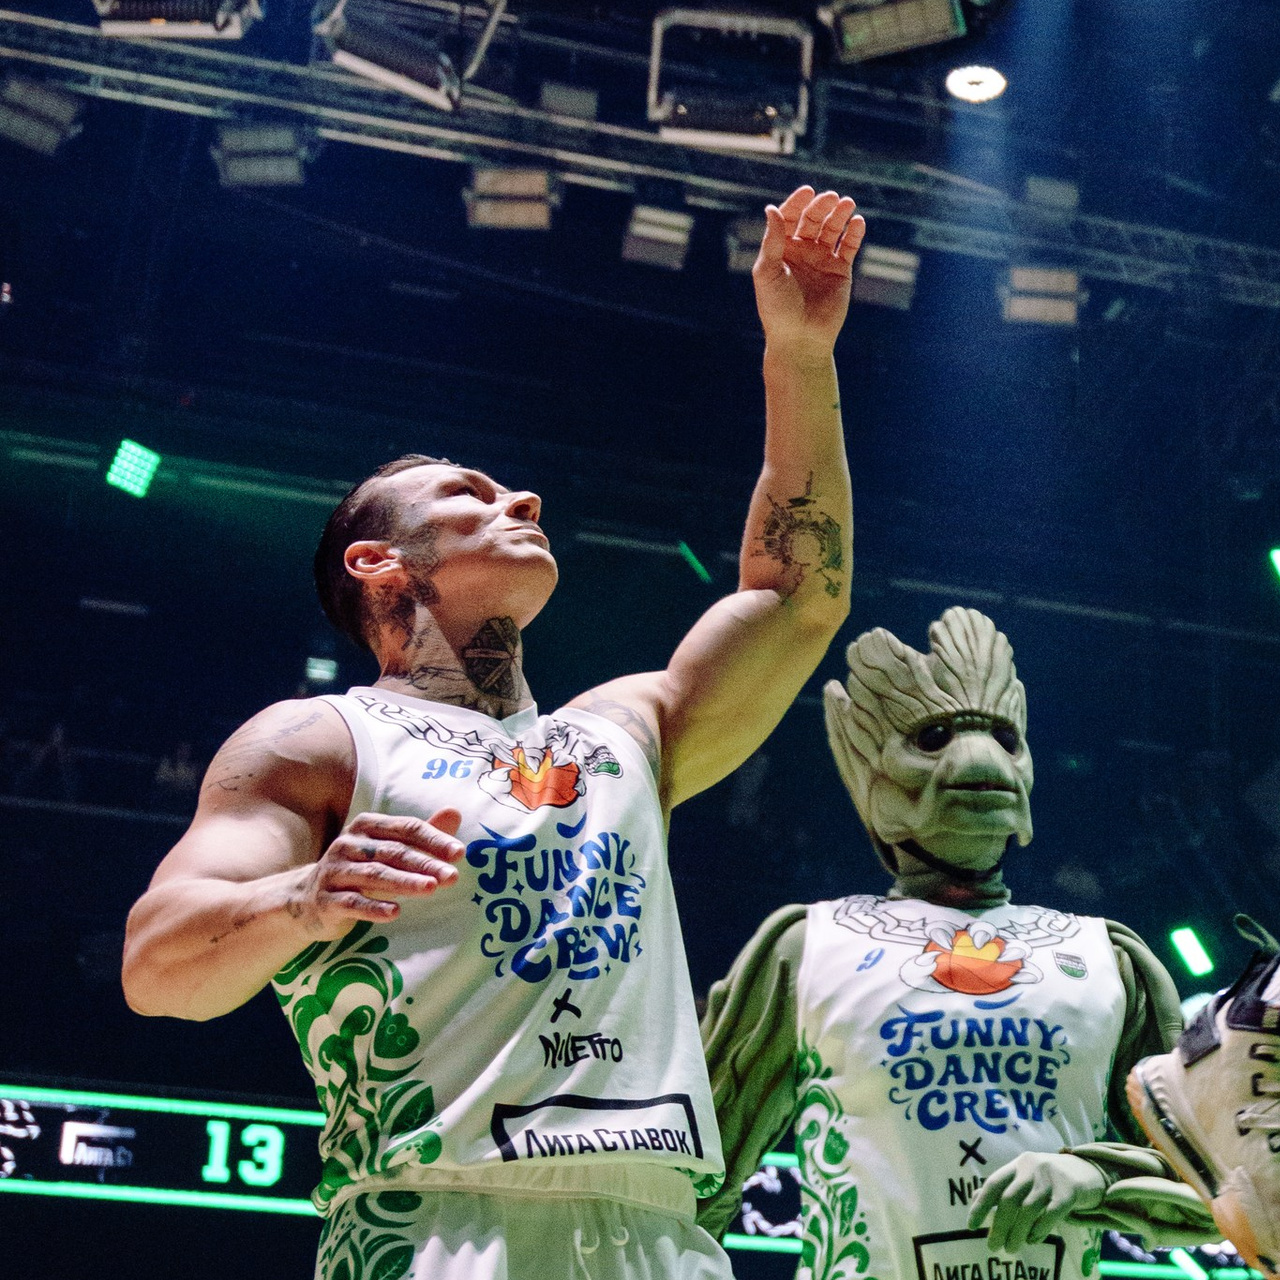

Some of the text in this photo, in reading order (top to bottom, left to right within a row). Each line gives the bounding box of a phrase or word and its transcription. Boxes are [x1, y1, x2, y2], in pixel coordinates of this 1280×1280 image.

[421, 758, 474, 780] 96
[466, 822, 636, 894] FUNNY
[485, 874, 645, 943] DANCE
[511, 922, 638, 984] CREW
[538, 1031, 623, 1069] NILETTO
[880, 1004, 1067, 1056] FUNNY
[890, 1051, 1062, 1090] DANCE
[916, 1088, 1054, 1134] CREW
[201, 1120, 285, 1186] 13
